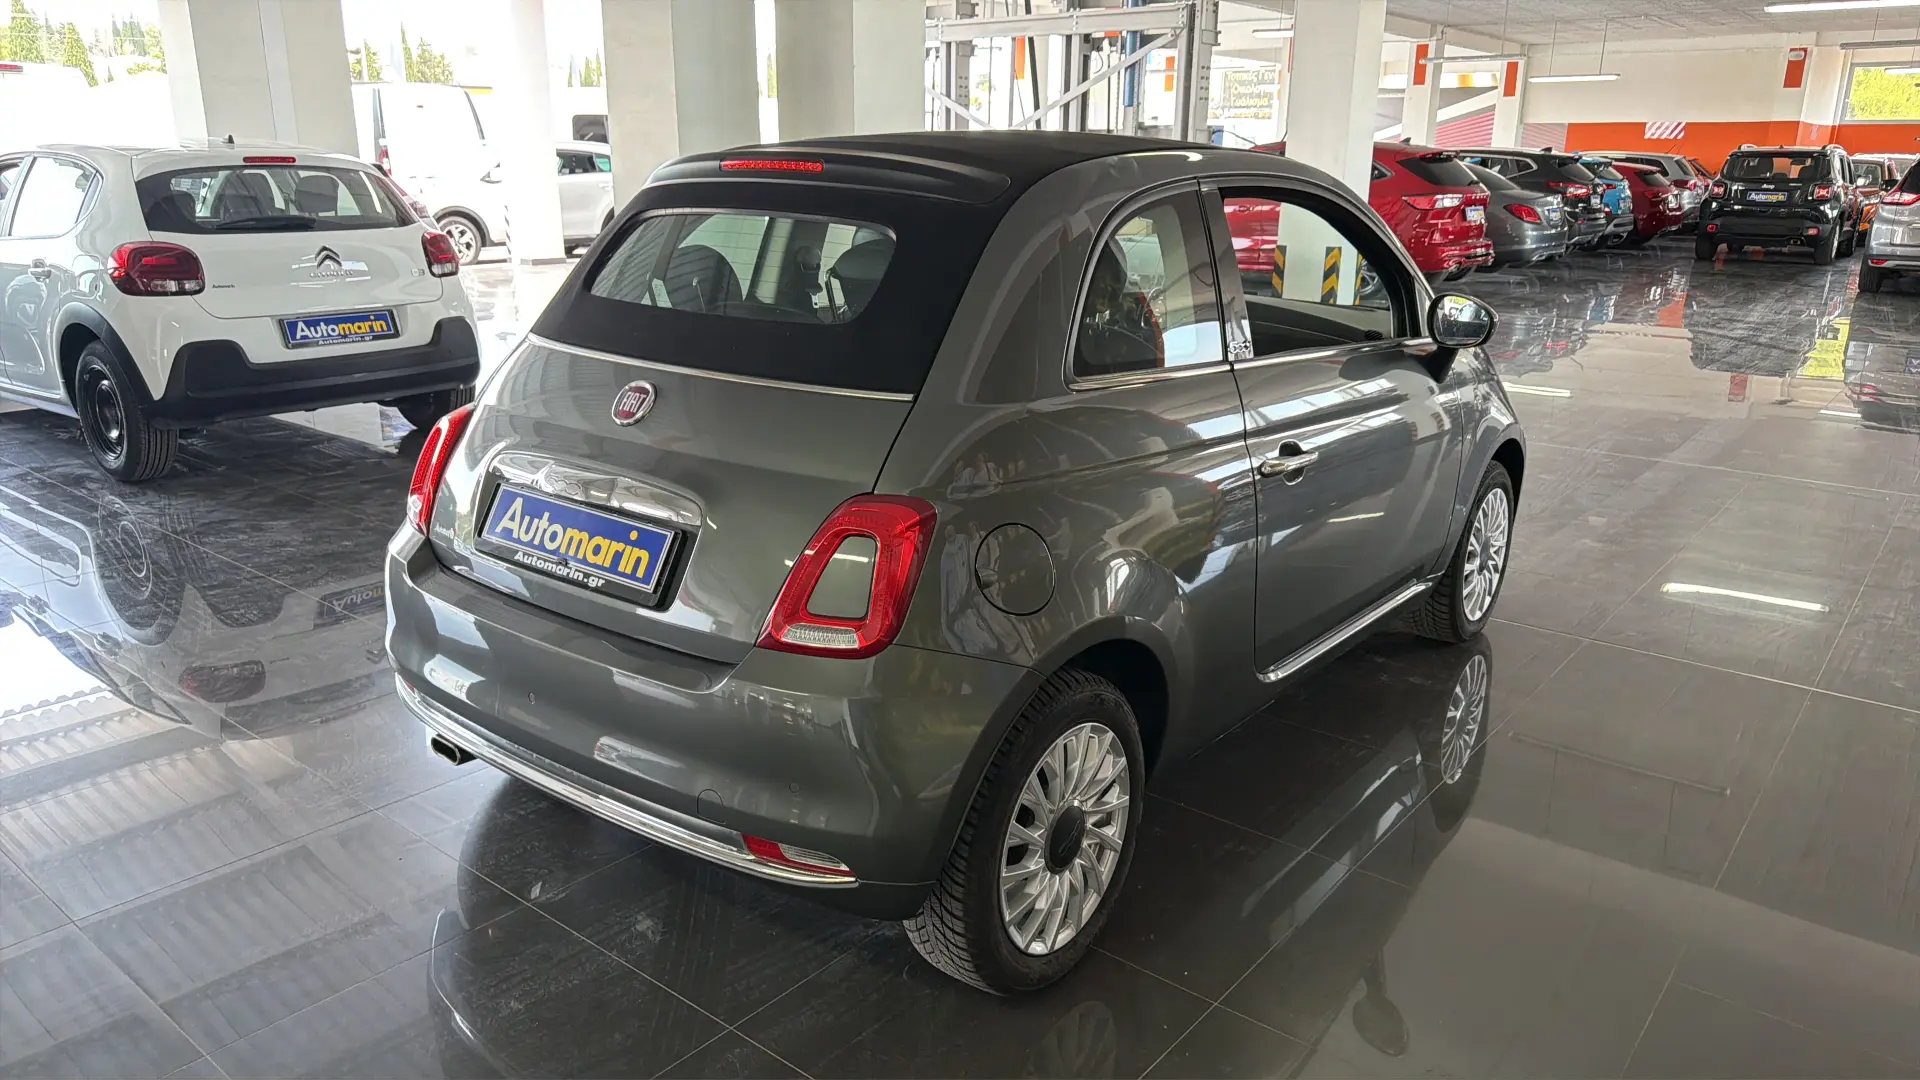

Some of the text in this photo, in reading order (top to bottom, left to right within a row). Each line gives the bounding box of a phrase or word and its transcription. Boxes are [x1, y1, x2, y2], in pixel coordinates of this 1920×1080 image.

[296, 315, 388, 340] Automarin
[318, 335, 373, 345] Automarin.gr
[619, 391, 647, 413] FIAT
[495, 497, 649, 579] Automarin
[513, 550, 606, 588] Automarin.gr
